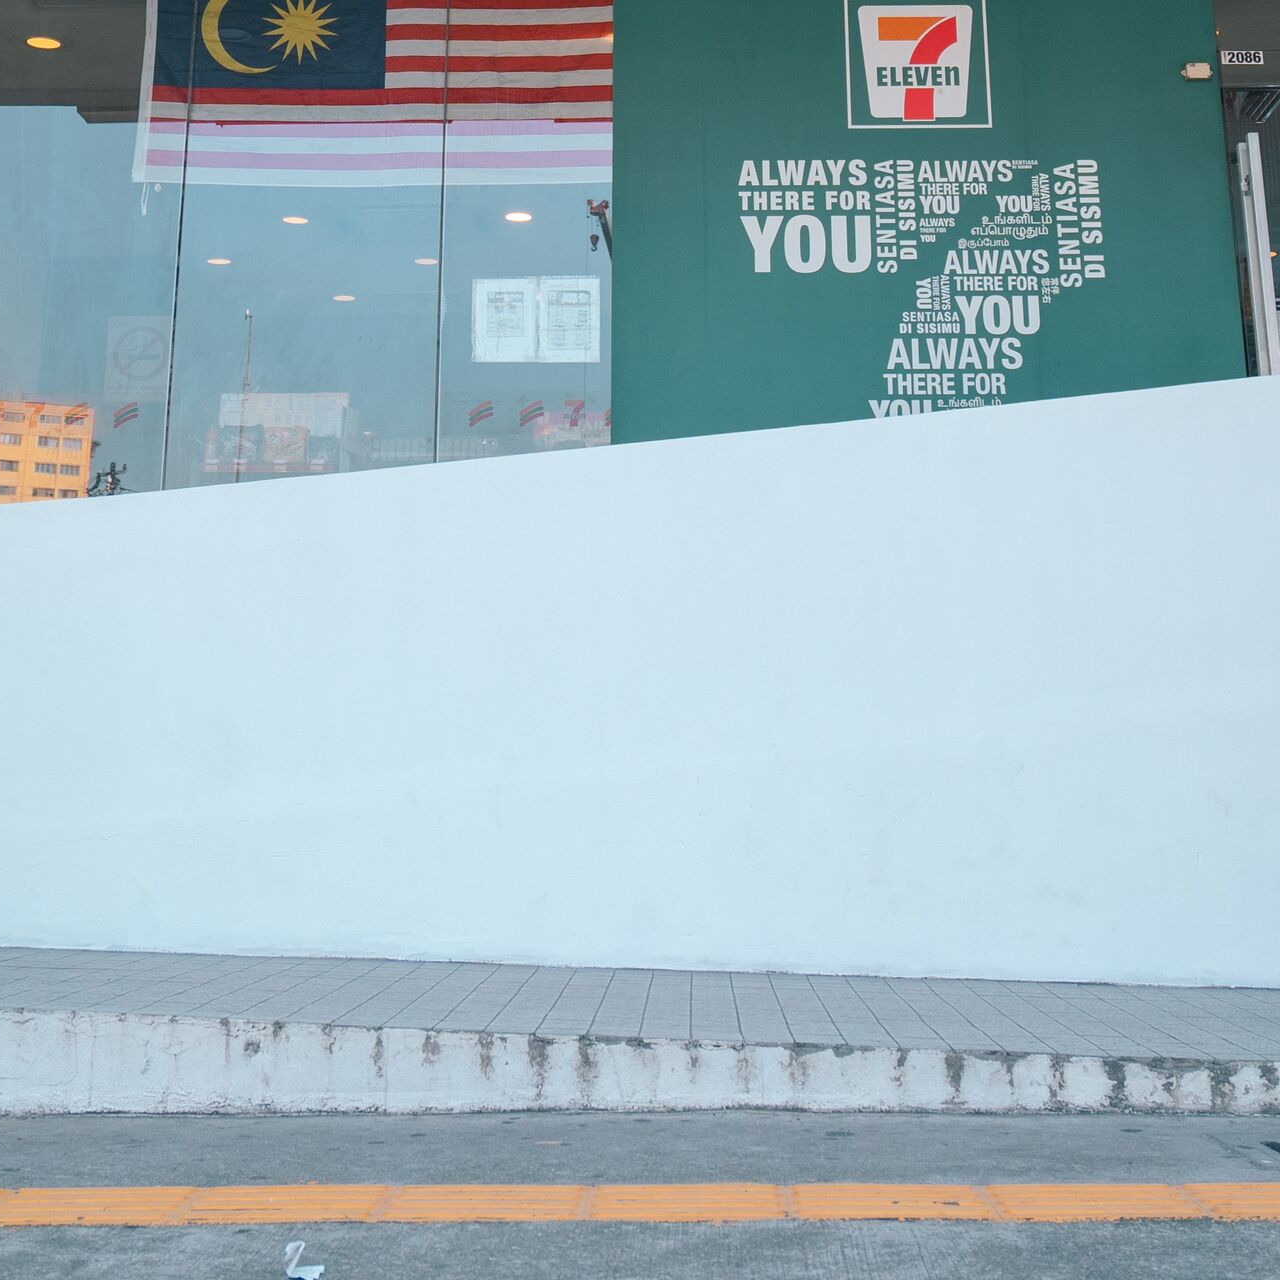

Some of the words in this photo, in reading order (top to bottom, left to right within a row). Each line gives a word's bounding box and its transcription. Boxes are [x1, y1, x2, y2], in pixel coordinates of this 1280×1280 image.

[878, 16, 957, 120] 7
[1227, 52, 1261, 63] 2086
[738, 159, 868, 186] ALWAYS
[918, 160, 1013, 182] ALWAYS
[896, 159, 917, 231] SISIMU
[919, 183, 959, 195] THERE
[963, 183, 987, 195] FOR
[1031, 175, 1039, 196] THERE
[1039, 172, 1051, 211] ALWAYS
[738, 191, 815, 210] THERE
[825, 190, 871, 210] FOR
[919, 195, 960, 214] YOU
[995, 195, 1032, 213] YOU
[1032, 198, 1040, 211] FOR
[1077, 159, 1103, 244] SISIMU
[874, 159, 898, 274] SENTIASA
[920, 218, 955, 227] ALWAYS
[1053, 163, 1083, 288] SENTIASA
[740, 214, 872, 273] YOU
[920, 234, 936, 242] YOU
[899, 240, 918, 260] DI
[943, 249, 1050, 274] ALWAYS
[1083, 254, 1106, 278] DI
[916, 278, 932, 309] YOU
[940, 275, 951, 310] ALWAYS
[954, 276, 1003, 291] THERE
[1008, 276, 1038, 291] FOR
[902, 312, 959, 322] SENTIASA
[954, 295, 1041, 335] YOU
[899, 323, 911, 334] DI
[916, 323, 960, 334] SISIMU
[886, 337, 1023, 370] ALWAYS
[883, 373, 955, 395] THERE
[962, 373, 1007, 395] FOR
[564, 400, 585, 427] 7
